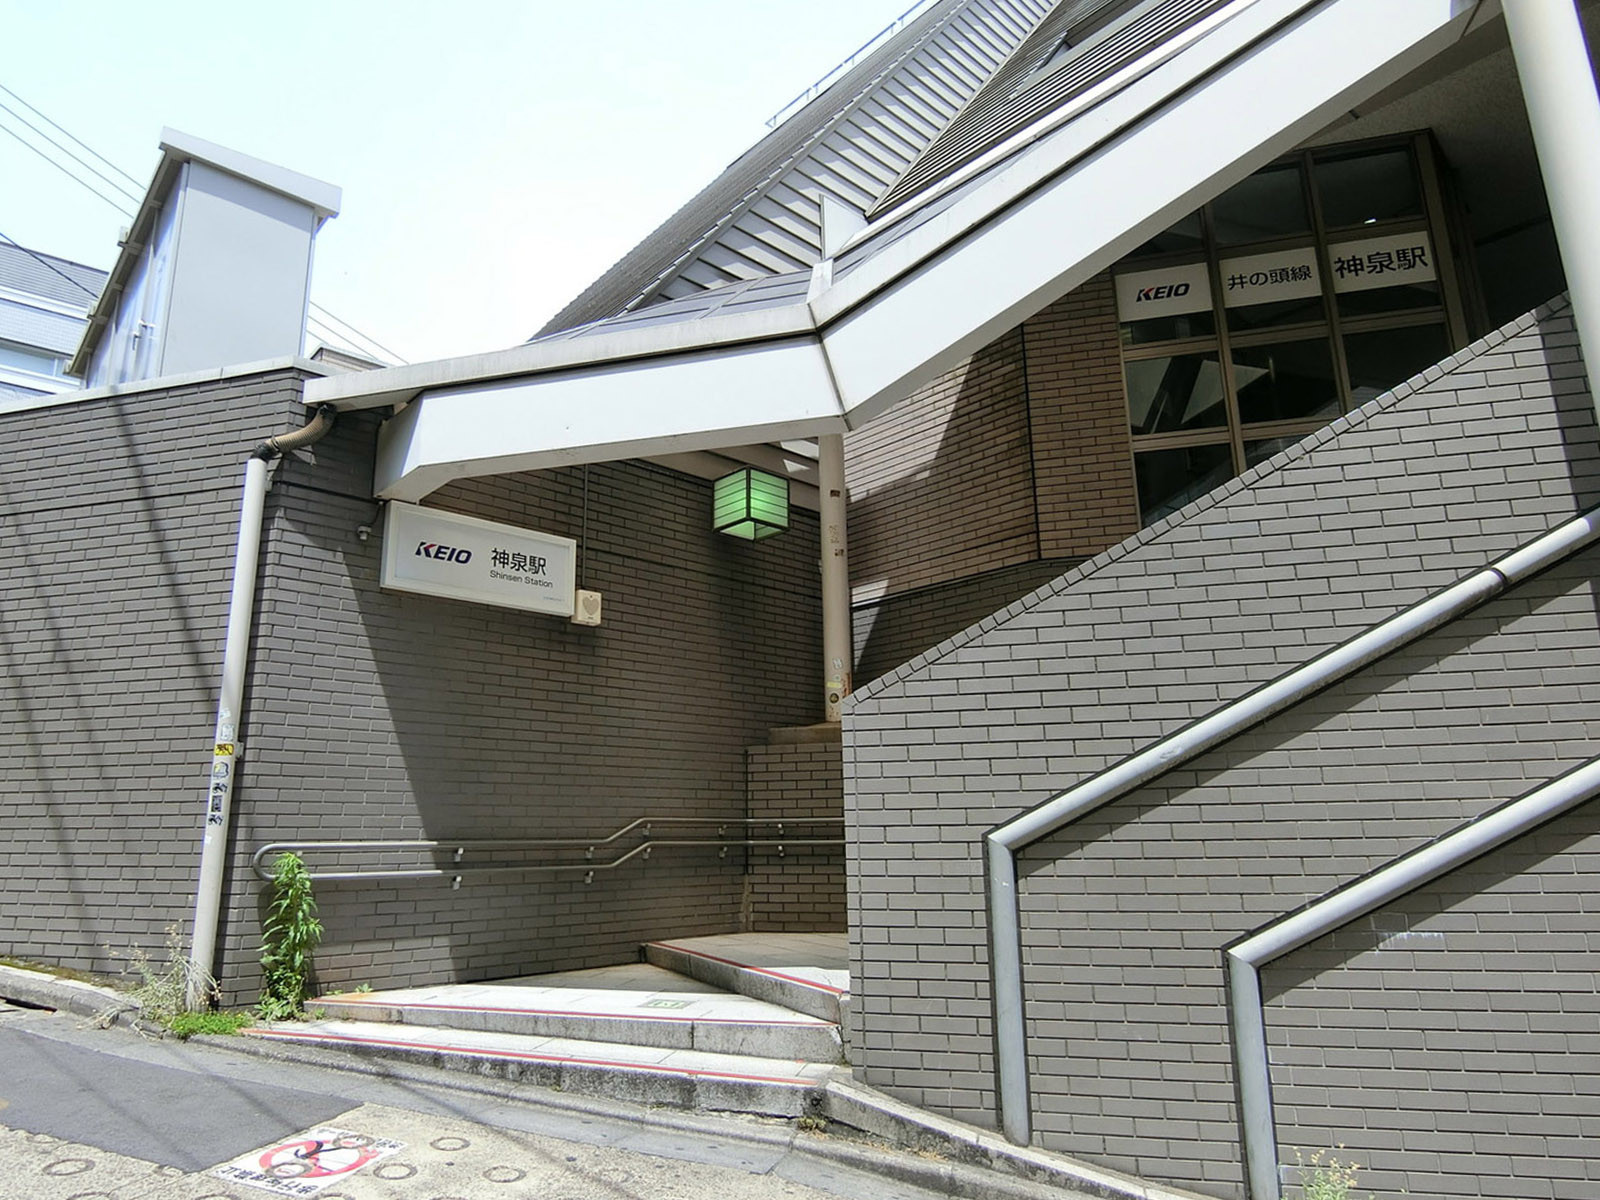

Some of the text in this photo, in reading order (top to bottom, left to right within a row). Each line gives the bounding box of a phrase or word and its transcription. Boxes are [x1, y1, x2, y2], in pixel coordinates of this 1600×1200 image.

[1334, 245, 1429, 279] 神泉駅
[1227, 264, 1312, 290] 井の頭線
[1136, 282, 1190, 303] KEIO
[415, 541, 547, 576] KEIO 神泉駅
[489, 570, 553, 588] Shinsen Station
